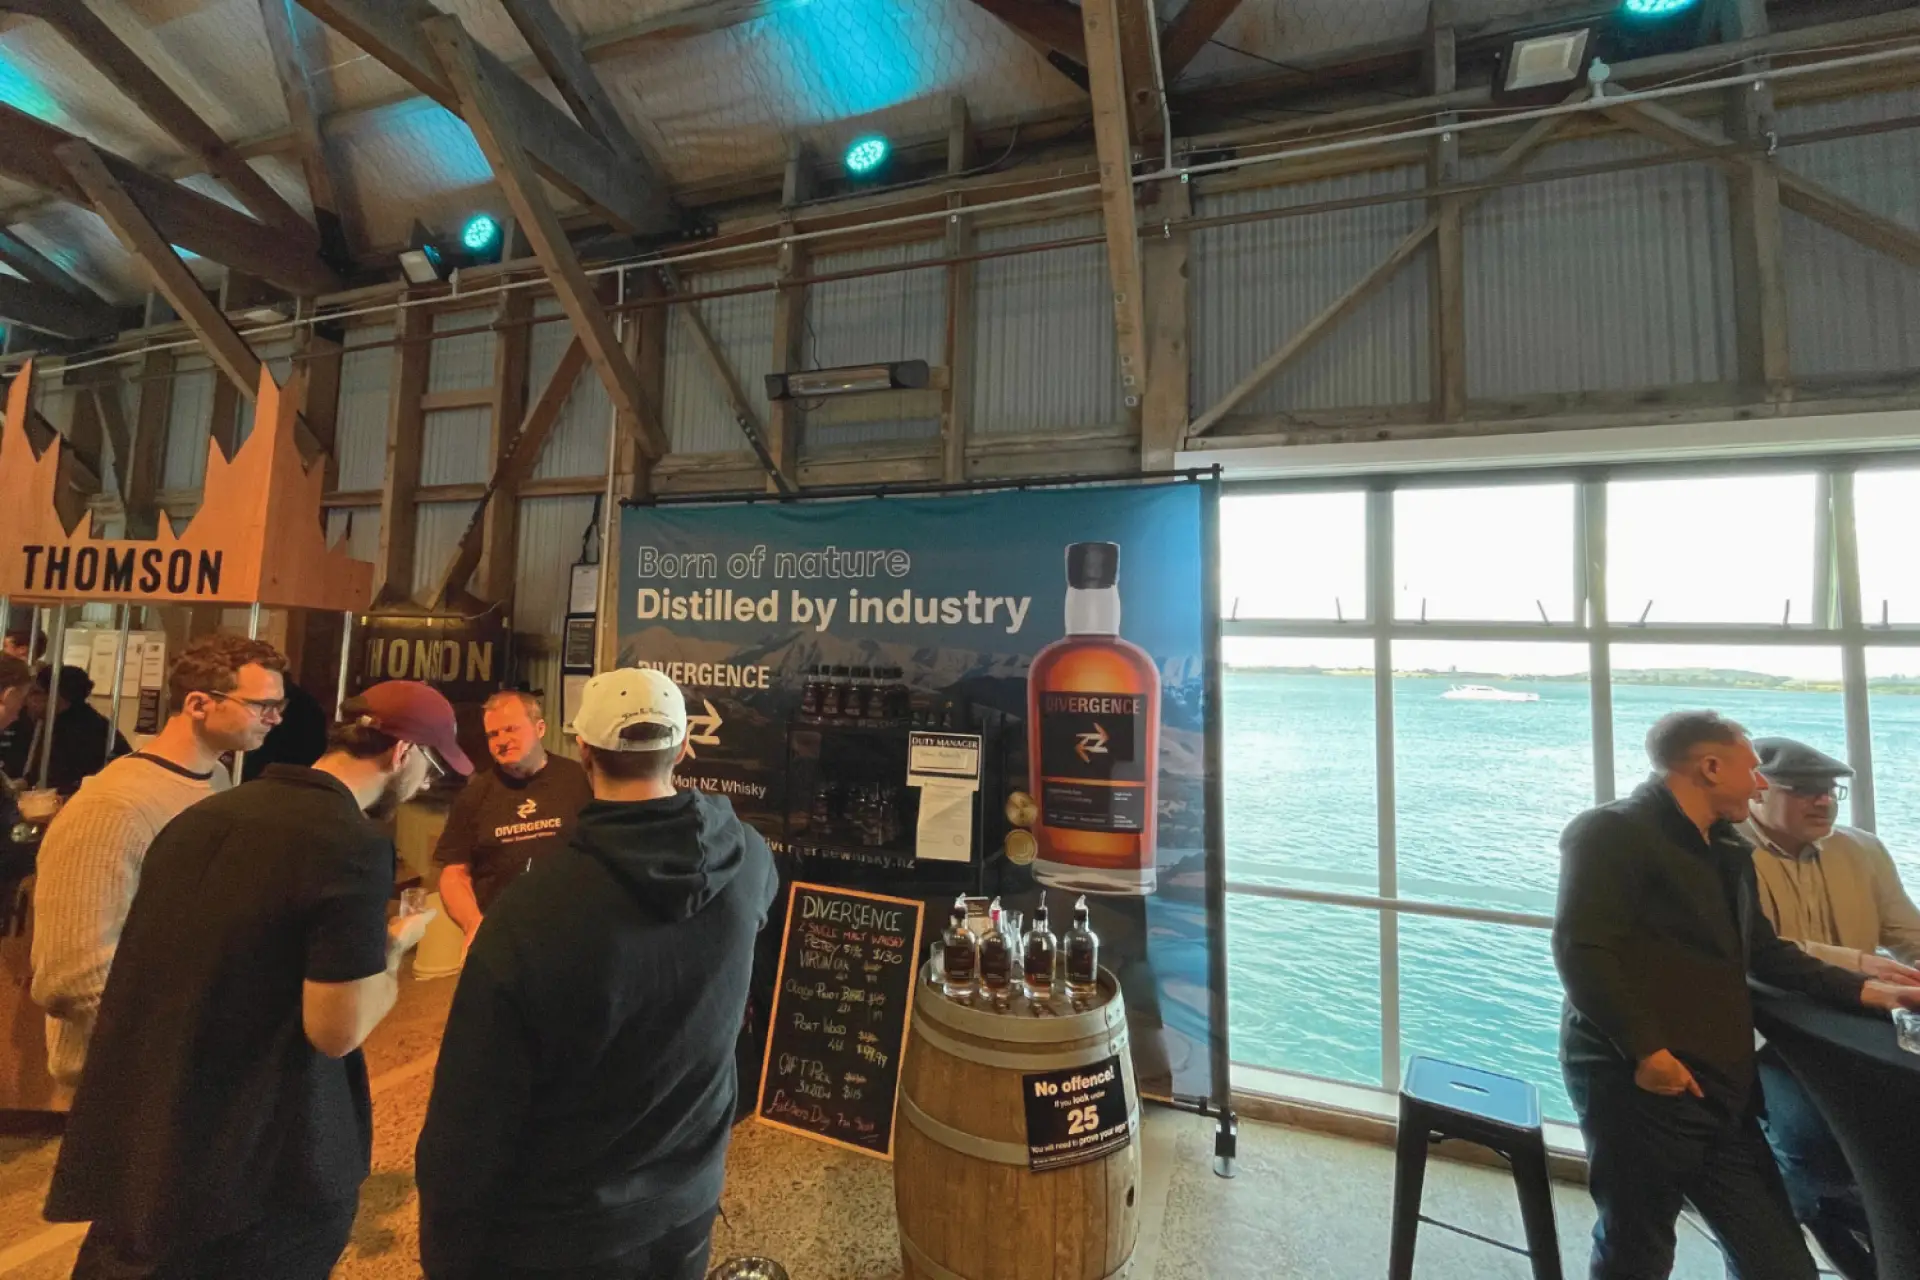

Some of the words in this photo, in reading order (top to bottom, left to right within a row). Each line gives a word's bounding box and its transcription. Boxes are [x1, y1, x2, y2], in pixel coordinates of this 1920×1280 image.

[23, 545, 223, 595] THOMSON
[638, 546, 717, 579] Born
[727, 544, 766, 579] of
[774, 545, 911, 579] nature
[637, 588, 779, 623] Distilled
[791, 590, 837, 632] by
[849, 588, 1032, 634] industry
[1047, 696, 1141, 715] DIVERGENCE
[912, 737, 935, 746] DUTY
[936, 739, 978, 749] MANAGER
[671, 774, 697, 788] Malt
[701, 777, 719, 791] NZ
[720, 780, 766, 799] Whisky
[495, 818, 561, 837] DIVERGENCE
[802, 895, 903, 932] DIVERGENCE
[872, 949, 903, 965] $130
[1034, 1081, 1058, 1097] No
[1062, 1065, 1115, 1093] offence!
[1060, 1100, 1072, 1109] you
[1072, 1093, 1089, 1104] look
[1067, 1105, 1099, 1135] 25
[1031, 1145, 1044, 1154] You
[1055, 1139, 1071, 1150] need
[1079, 1133, 1099, 1147] prove
[1100, 1127, 1114, 1141] your
